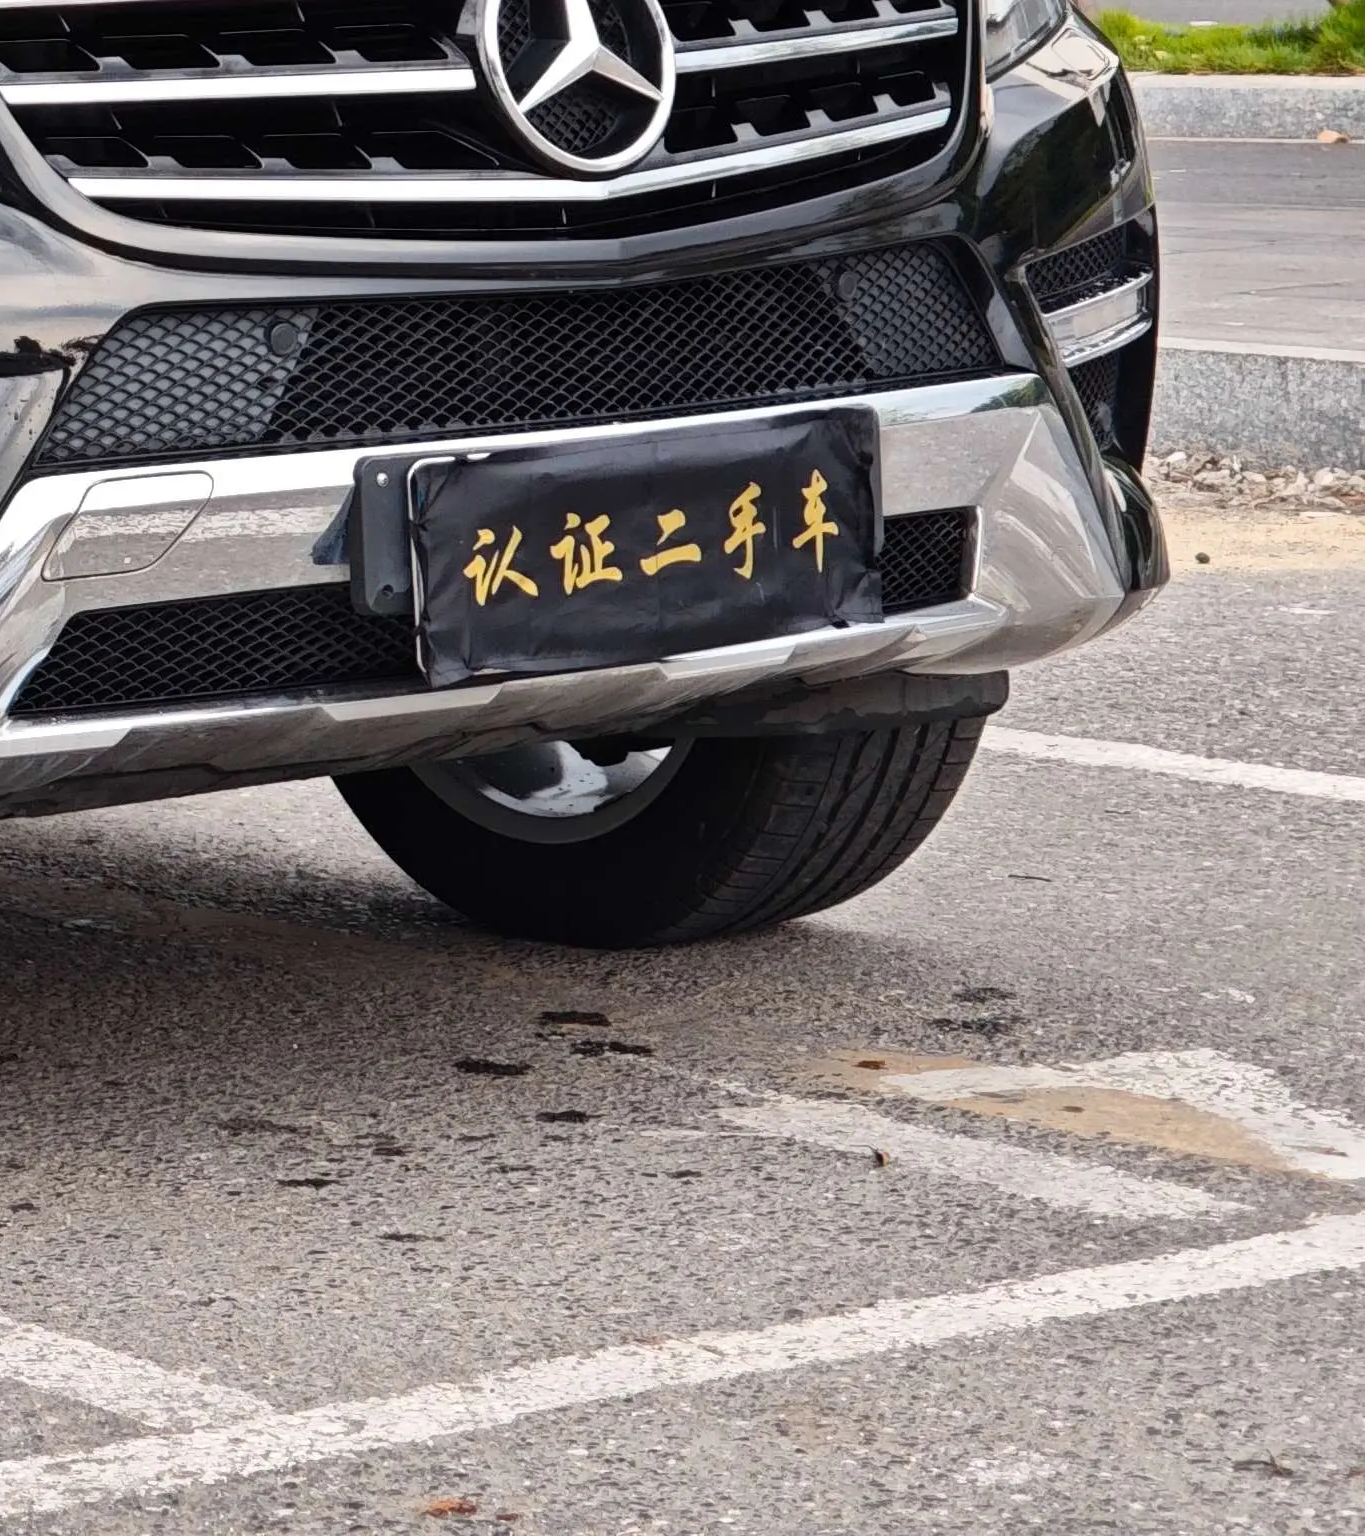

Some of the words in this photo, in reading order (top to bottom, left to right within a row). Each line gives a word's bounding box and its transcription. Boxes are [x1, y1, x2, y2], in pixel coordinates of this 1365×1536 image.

[462, 468, 840, 607] 认证二手车
